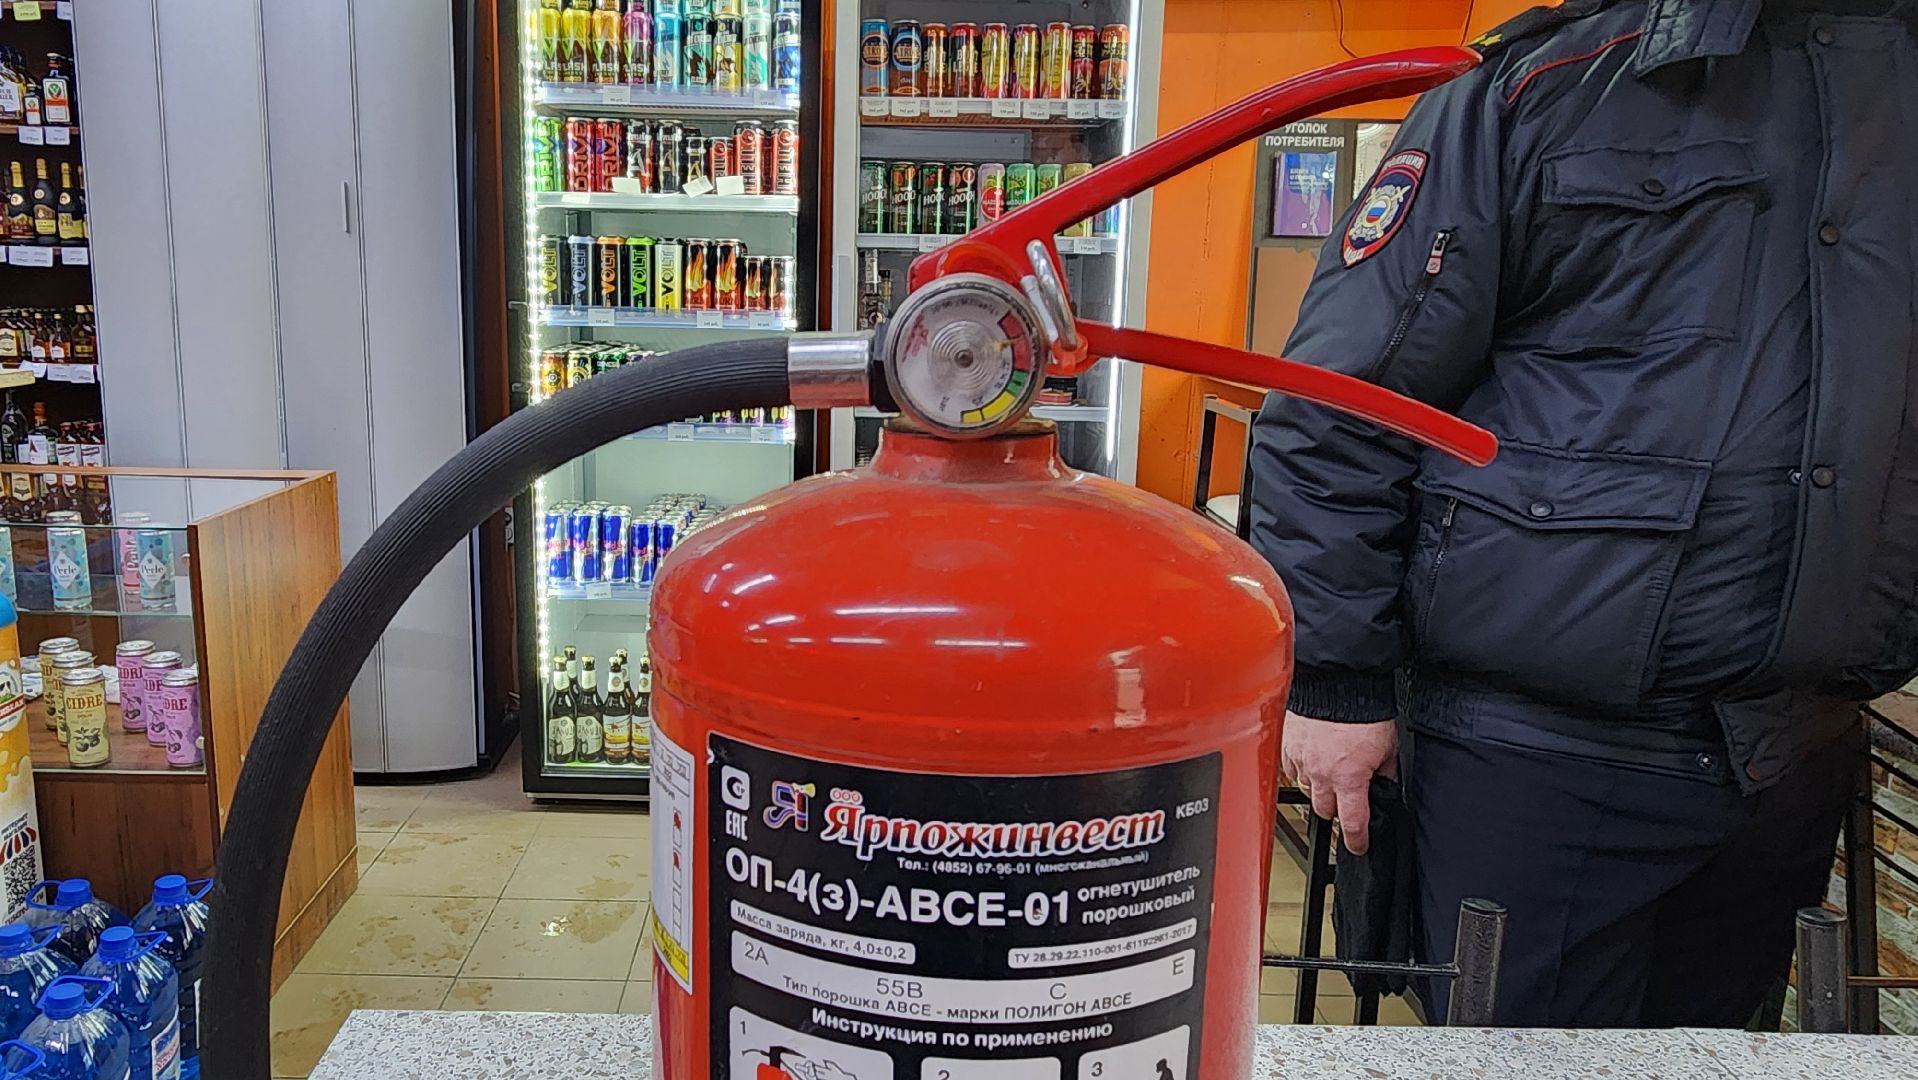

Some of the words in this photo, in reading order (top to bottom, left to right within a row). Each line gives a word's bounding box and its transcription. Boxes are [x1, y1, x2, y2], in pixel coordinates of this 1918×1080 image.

[1265, 135, 1345, 148] ПОТРЕБИТЕЛЯ
[1285, 122, 1327, 134] УГОЛОК
[573, 121, 588, 191] DRIVE
[741, 147, 756, 186] HELL
[541, 247, 557, 296] VOLT
[571, 247, 586, 296] VOLT
[601, 249, 616, 296] VOLT
[632, 249, 647, 298] VOLT
[661, 250, 675, 297] VOLT
[66, 694, 104, 710] CIDRE
[820, 802, 1166, 861] Ярпожинвест
[932, 862, 973, 876] (4852)
[975, 860, 1031, 875] 67-96-01
[1077, 864, 1201, 902] огнетушитель
[1082, 886, 1195, 925] порошковый
[737, 906, 772, 930] Масса
[776, 922, 826, 947] заряда,
[830, 938, 849, 953] кг,
[744, 941, 770, 966] 2А
[876, 977, 924, 999] 55В
[1015, 953, 1030, 963] ТУ
[783, 975, 808, 994] Тип
[812, 983, 880, 1011] порошка
[885, 1001, 932, 1018] АВСЕ
[947, 1008, 999, 1024] марки
[1004, 1002, 1087, 1020] ПОЛИГОН
[740, 1020, 747, 1036] 1
[811, 1008, 938, 1046] Инструкция
[942, 1031, 969, 1048] по
[974, 1021, 1113, 1051] применению
[1091, 1061, 1104, 1077] 3
